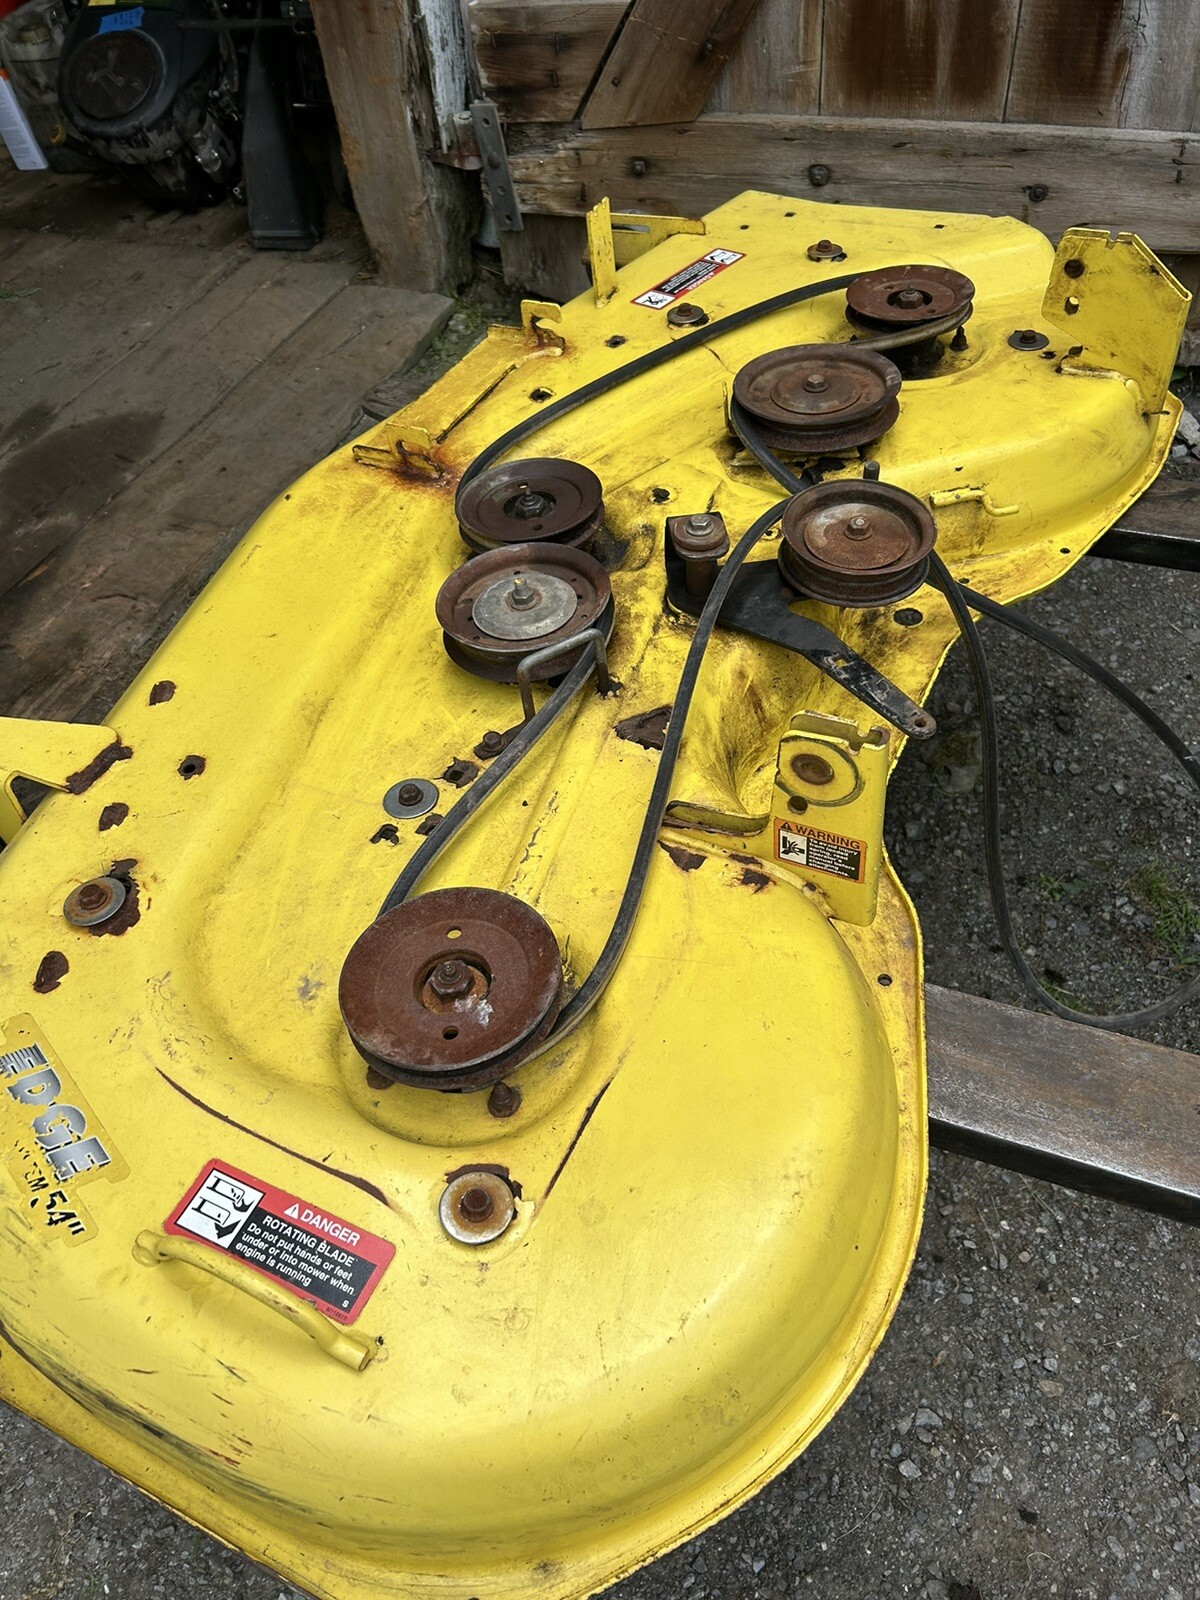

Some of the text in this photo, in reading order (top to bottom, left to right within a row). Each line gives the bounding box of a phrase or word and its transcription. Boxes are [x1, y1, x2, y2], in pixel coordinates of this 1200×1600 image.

[795, 825, 860, 849] WARNING
[839, 847, 858, 855] injury
[809, 855, 855, 870] manual before
[263, 1215, 354, 1267] ROTATING BLADE
[300, 1209, 361, 1246] DANGER
[235, 1243, 312, 1287] engine is running
[243, 1233, 354, 1295] under or into mower when
[247, 1222, 353, 1281] Do not put hands or feet
